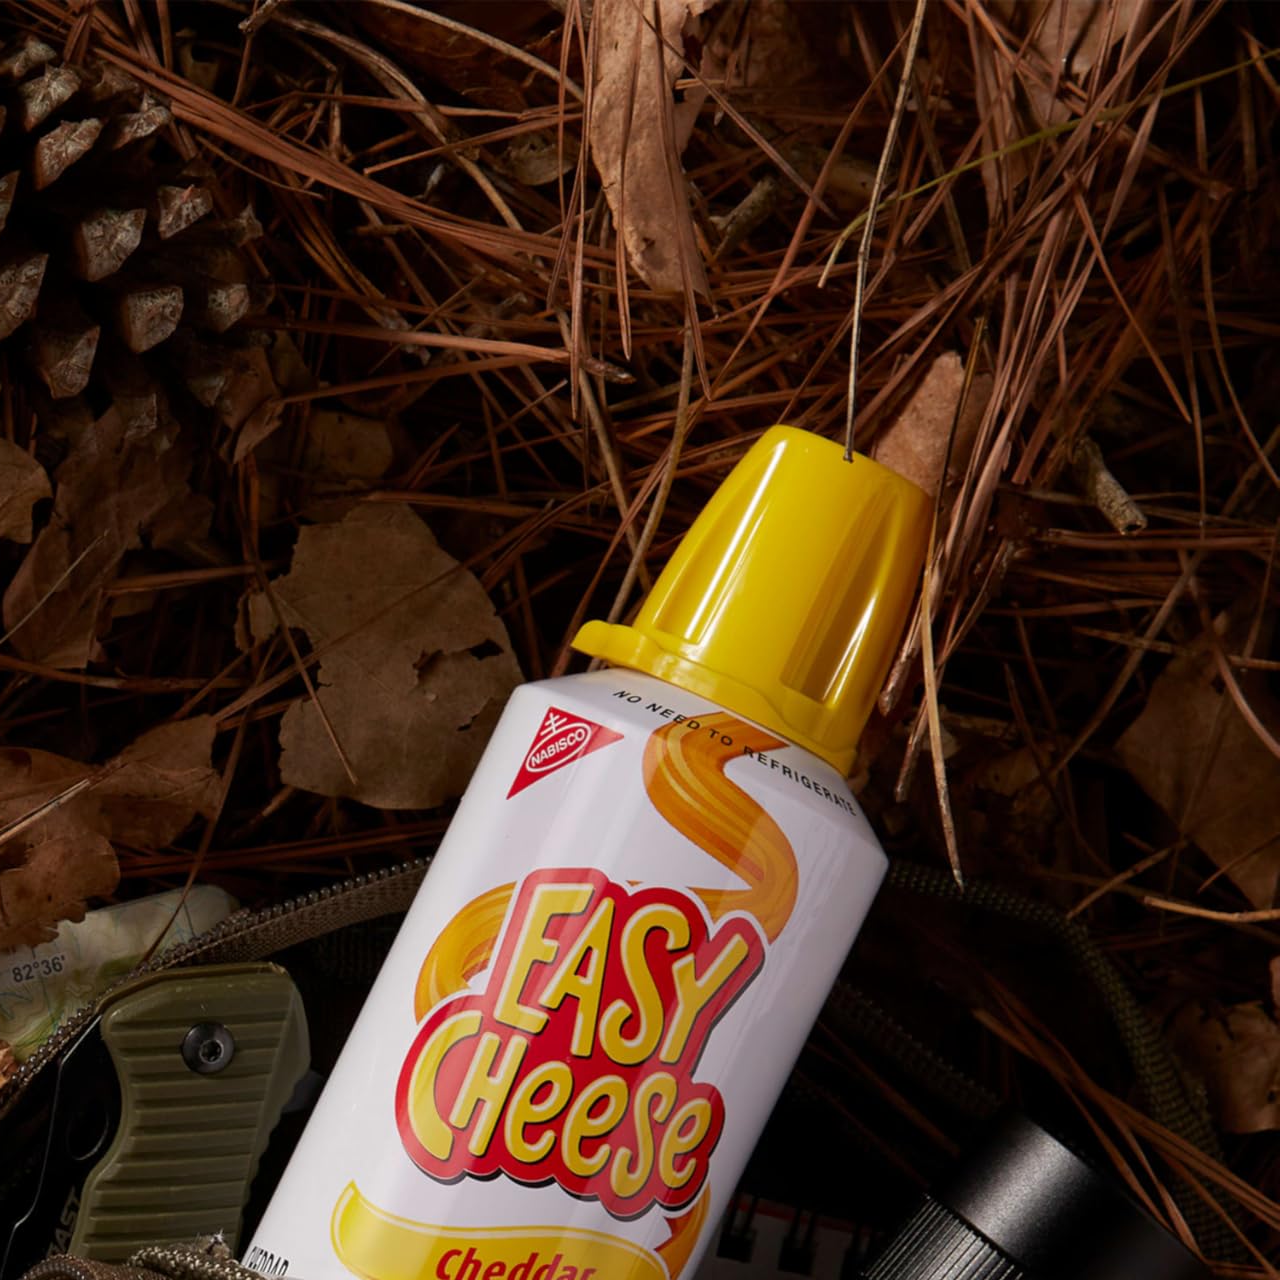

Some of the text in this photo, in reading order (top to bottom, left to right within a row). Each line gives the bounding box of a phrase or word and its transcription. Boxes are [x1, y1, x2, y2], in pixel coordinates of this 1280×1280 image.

[530, 727, 586, 768] NABISCO
[613, 690, 857, 816] NO NEED TO REFRIGERATE
[490, 879, 750, 1068] EASY
